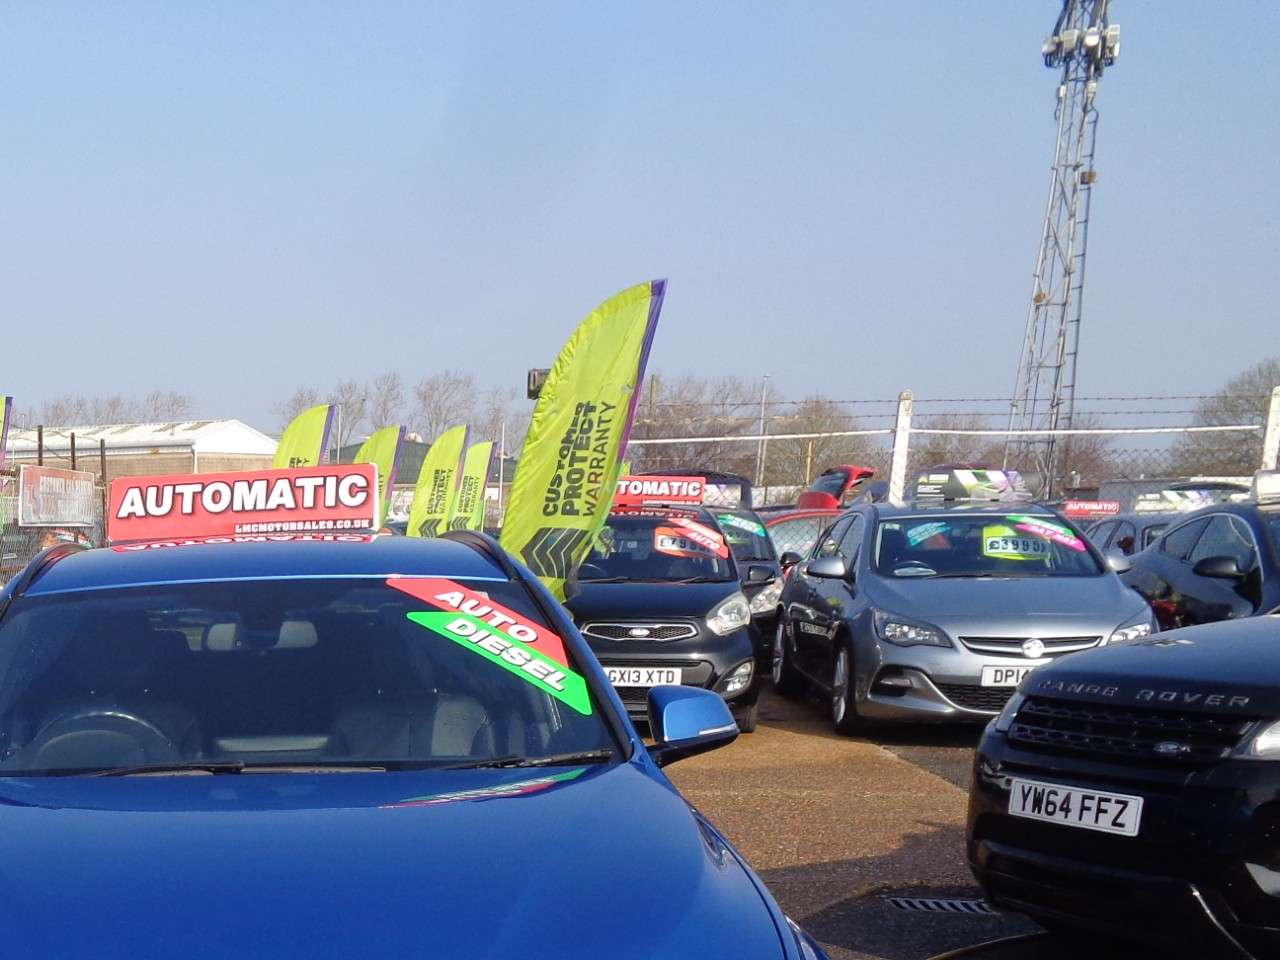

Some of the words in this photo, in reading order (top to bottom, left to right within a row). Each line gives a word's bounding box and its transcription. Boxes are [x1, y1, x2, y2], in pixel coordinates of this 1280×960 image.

[542, 401, 586, 517] CUSTOMER
[561, 401, 597, 516] PROTECT
[583, 401, 616, 517] WARRANTY
[116, 474, 369, 520] AUTOMATIC
[618, 481, 701, 497] TOMATIC
[234, 519, 370, 533] LMCMOTORSALES.CO.UK
[687, 531, 721, 550] AUTO
[433, 591, 538, 643] AUTO
[444, 617, 569, 692] DIESEL
[608, 669, 641, 683] GX13
[646, 670, 675, 683] XTD
[1038, 680, 1120, 697] RANGE
[1136, 688, 1251, 708] ROVER
[1019, 784, 1071, 820] YW64
[1078, 794, 1130, 829] FFZ
